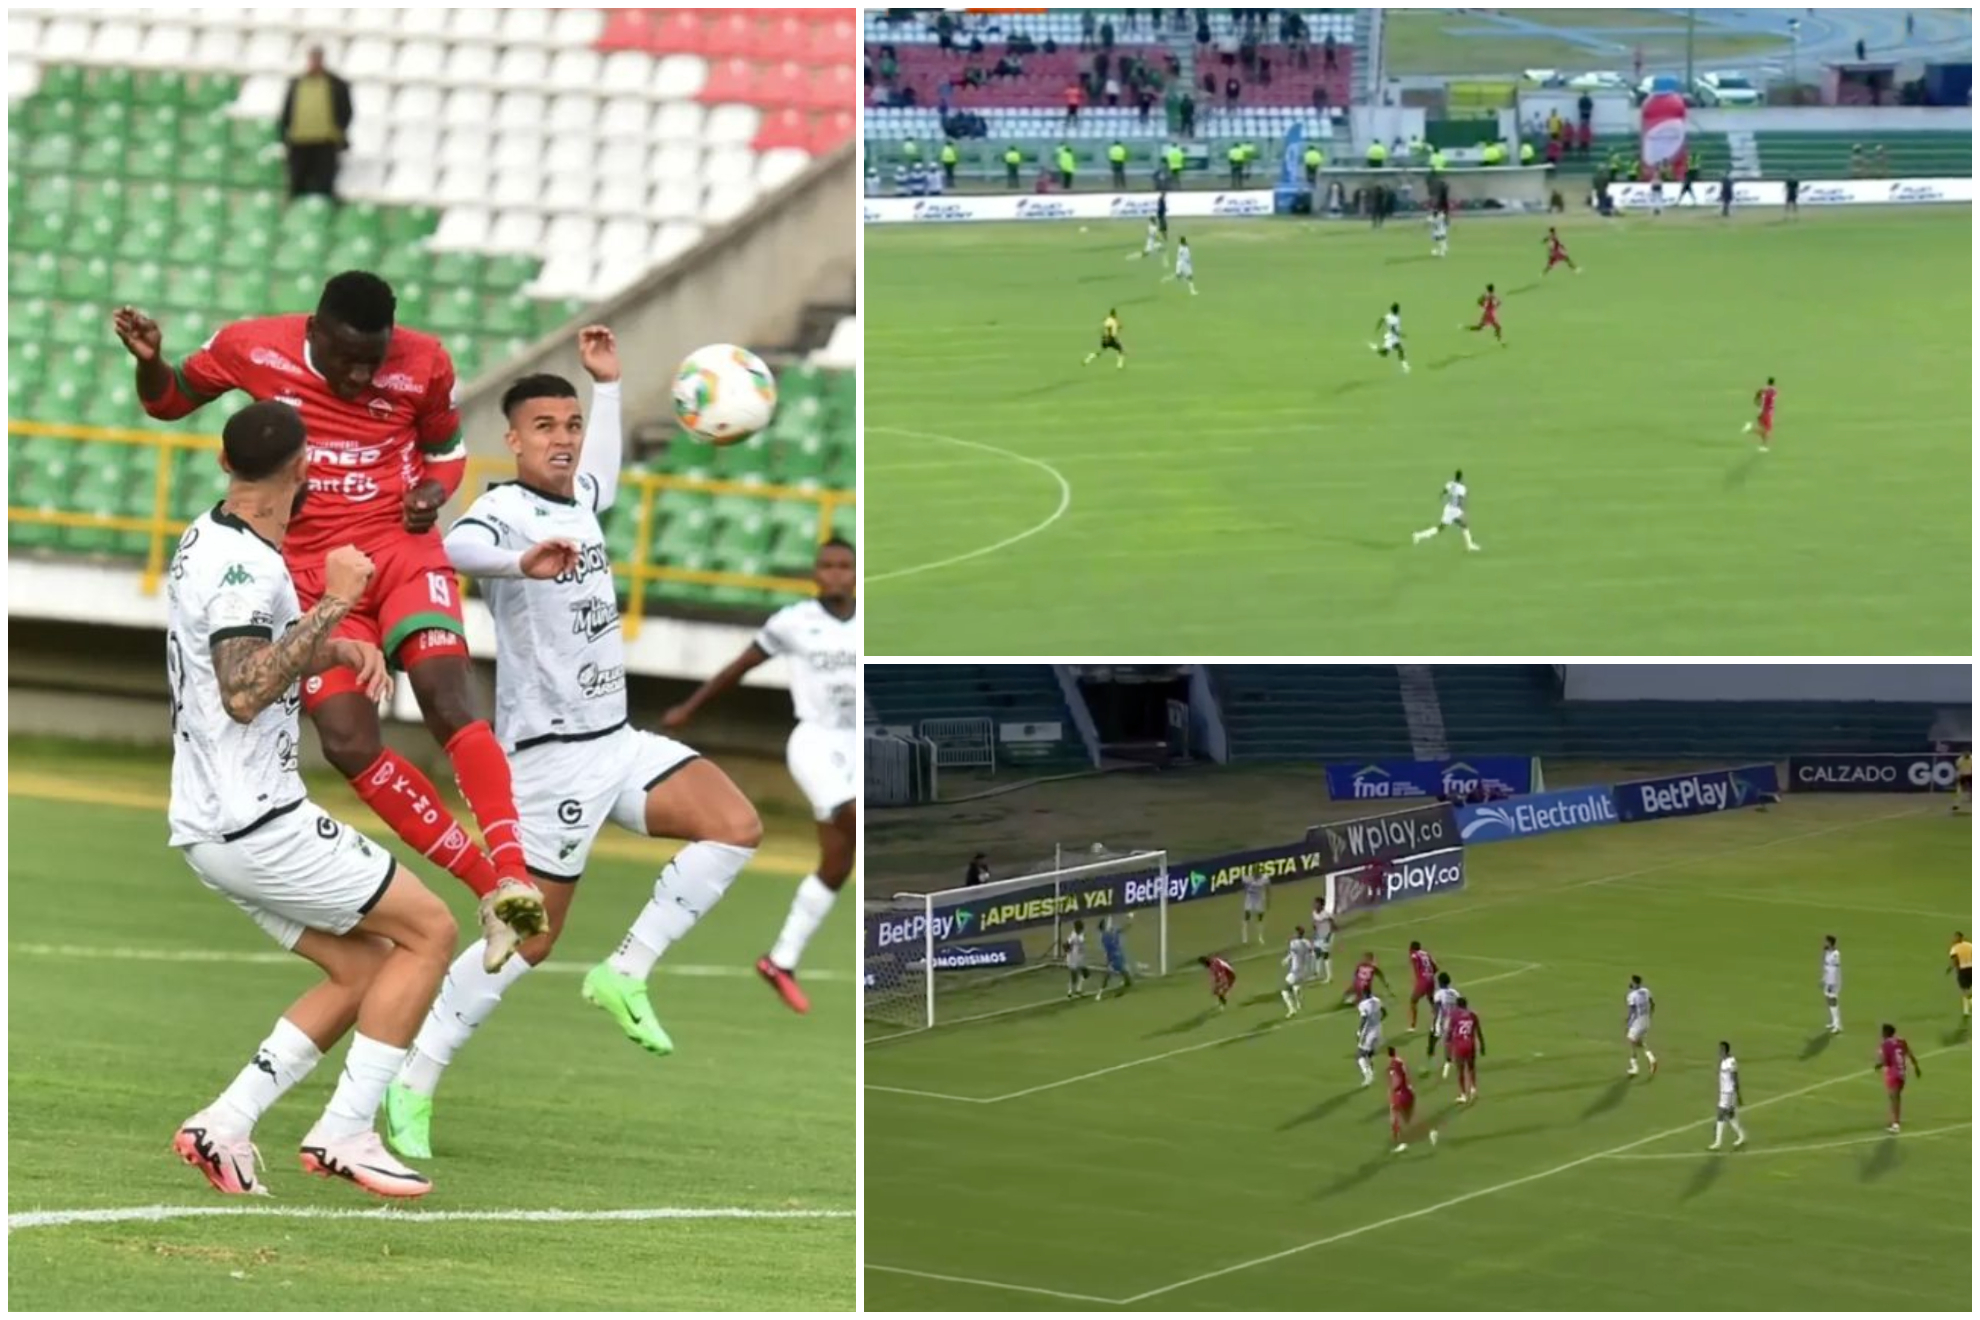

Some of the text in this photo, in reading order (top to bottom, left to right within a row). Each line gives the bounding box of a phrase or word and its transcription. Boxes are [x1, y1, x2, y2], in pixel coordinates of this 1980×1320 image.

[425, 571, 451, 608] 19
[1352, 776, 1390, 798] fna
[1798, 765, 1897, 782] CALZADO
[1515, 794, 1615, 833] Electrolit
[1640, 777, 1728, 813] BetPlay
[1347, 818, 1443, 857] Wplay.co
[1385, 862, 1460, 900] play.co
[878, 913, 953, 947] BetPay
[1084, 888, 1113, 909] YA!
